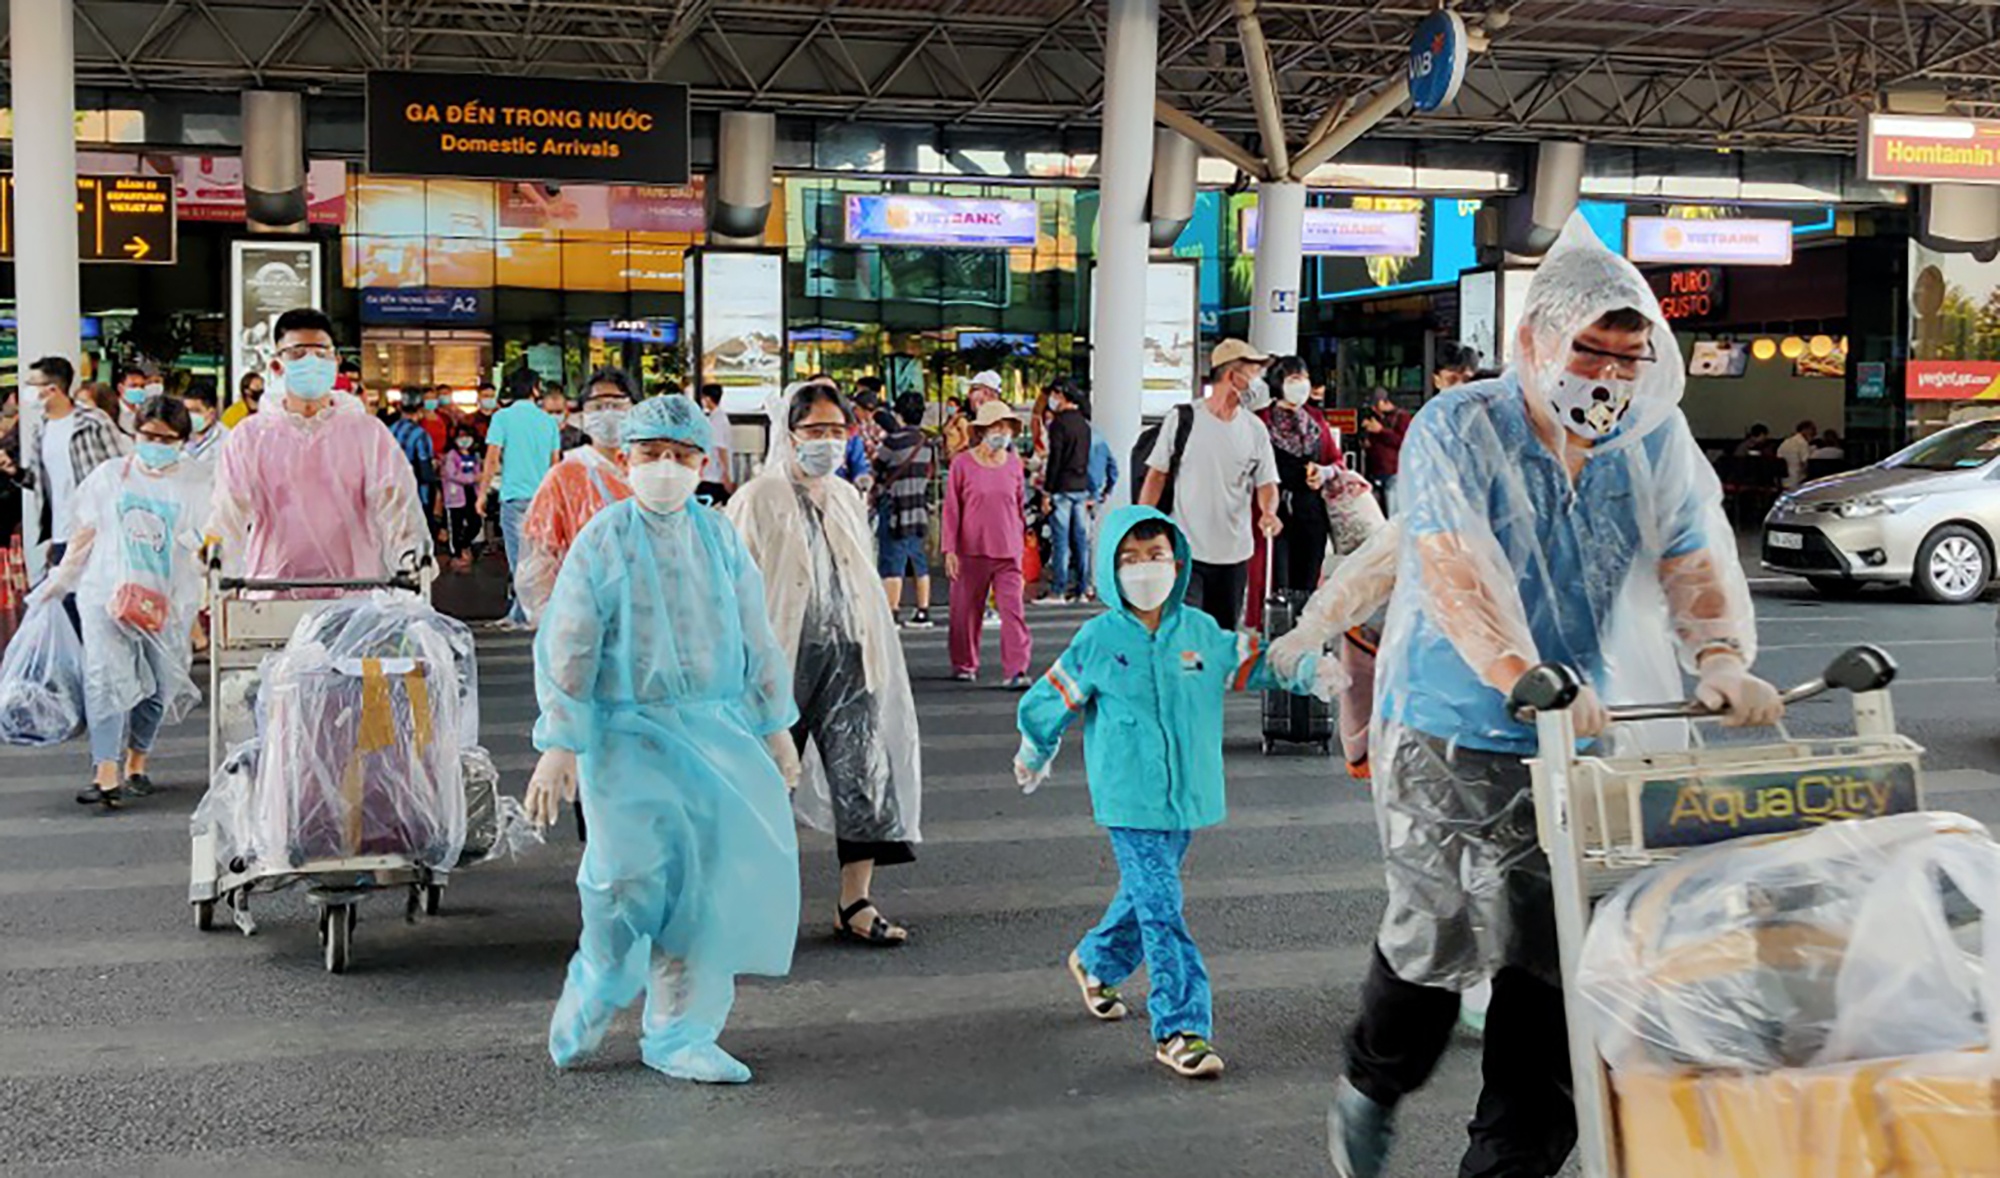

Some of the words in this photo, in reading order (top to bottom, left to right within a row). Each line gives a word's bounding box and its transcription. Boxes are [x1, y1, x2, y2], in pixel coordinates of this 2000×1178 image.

[406, 103, 439, 122] GA
[446, 99, 495, 124] ĐẾN
[501, 106, 582, 128] TRONG
[588, 107, 653, 131] NƯỚC
[441, 133, 537, 153] Domestic
[542, 138, 619, 157] Arrivals
[1886, 140, 1994, 166] Homtamin
[1687, 232, 1760, 245] VIETBANK
[1670, 269, 1711, 293] PURO
[451, 296, 477, 313] A2
[1660, 294, 1711, 319] GUSTO
[1668, 774, 1893, 828] AquaCity
